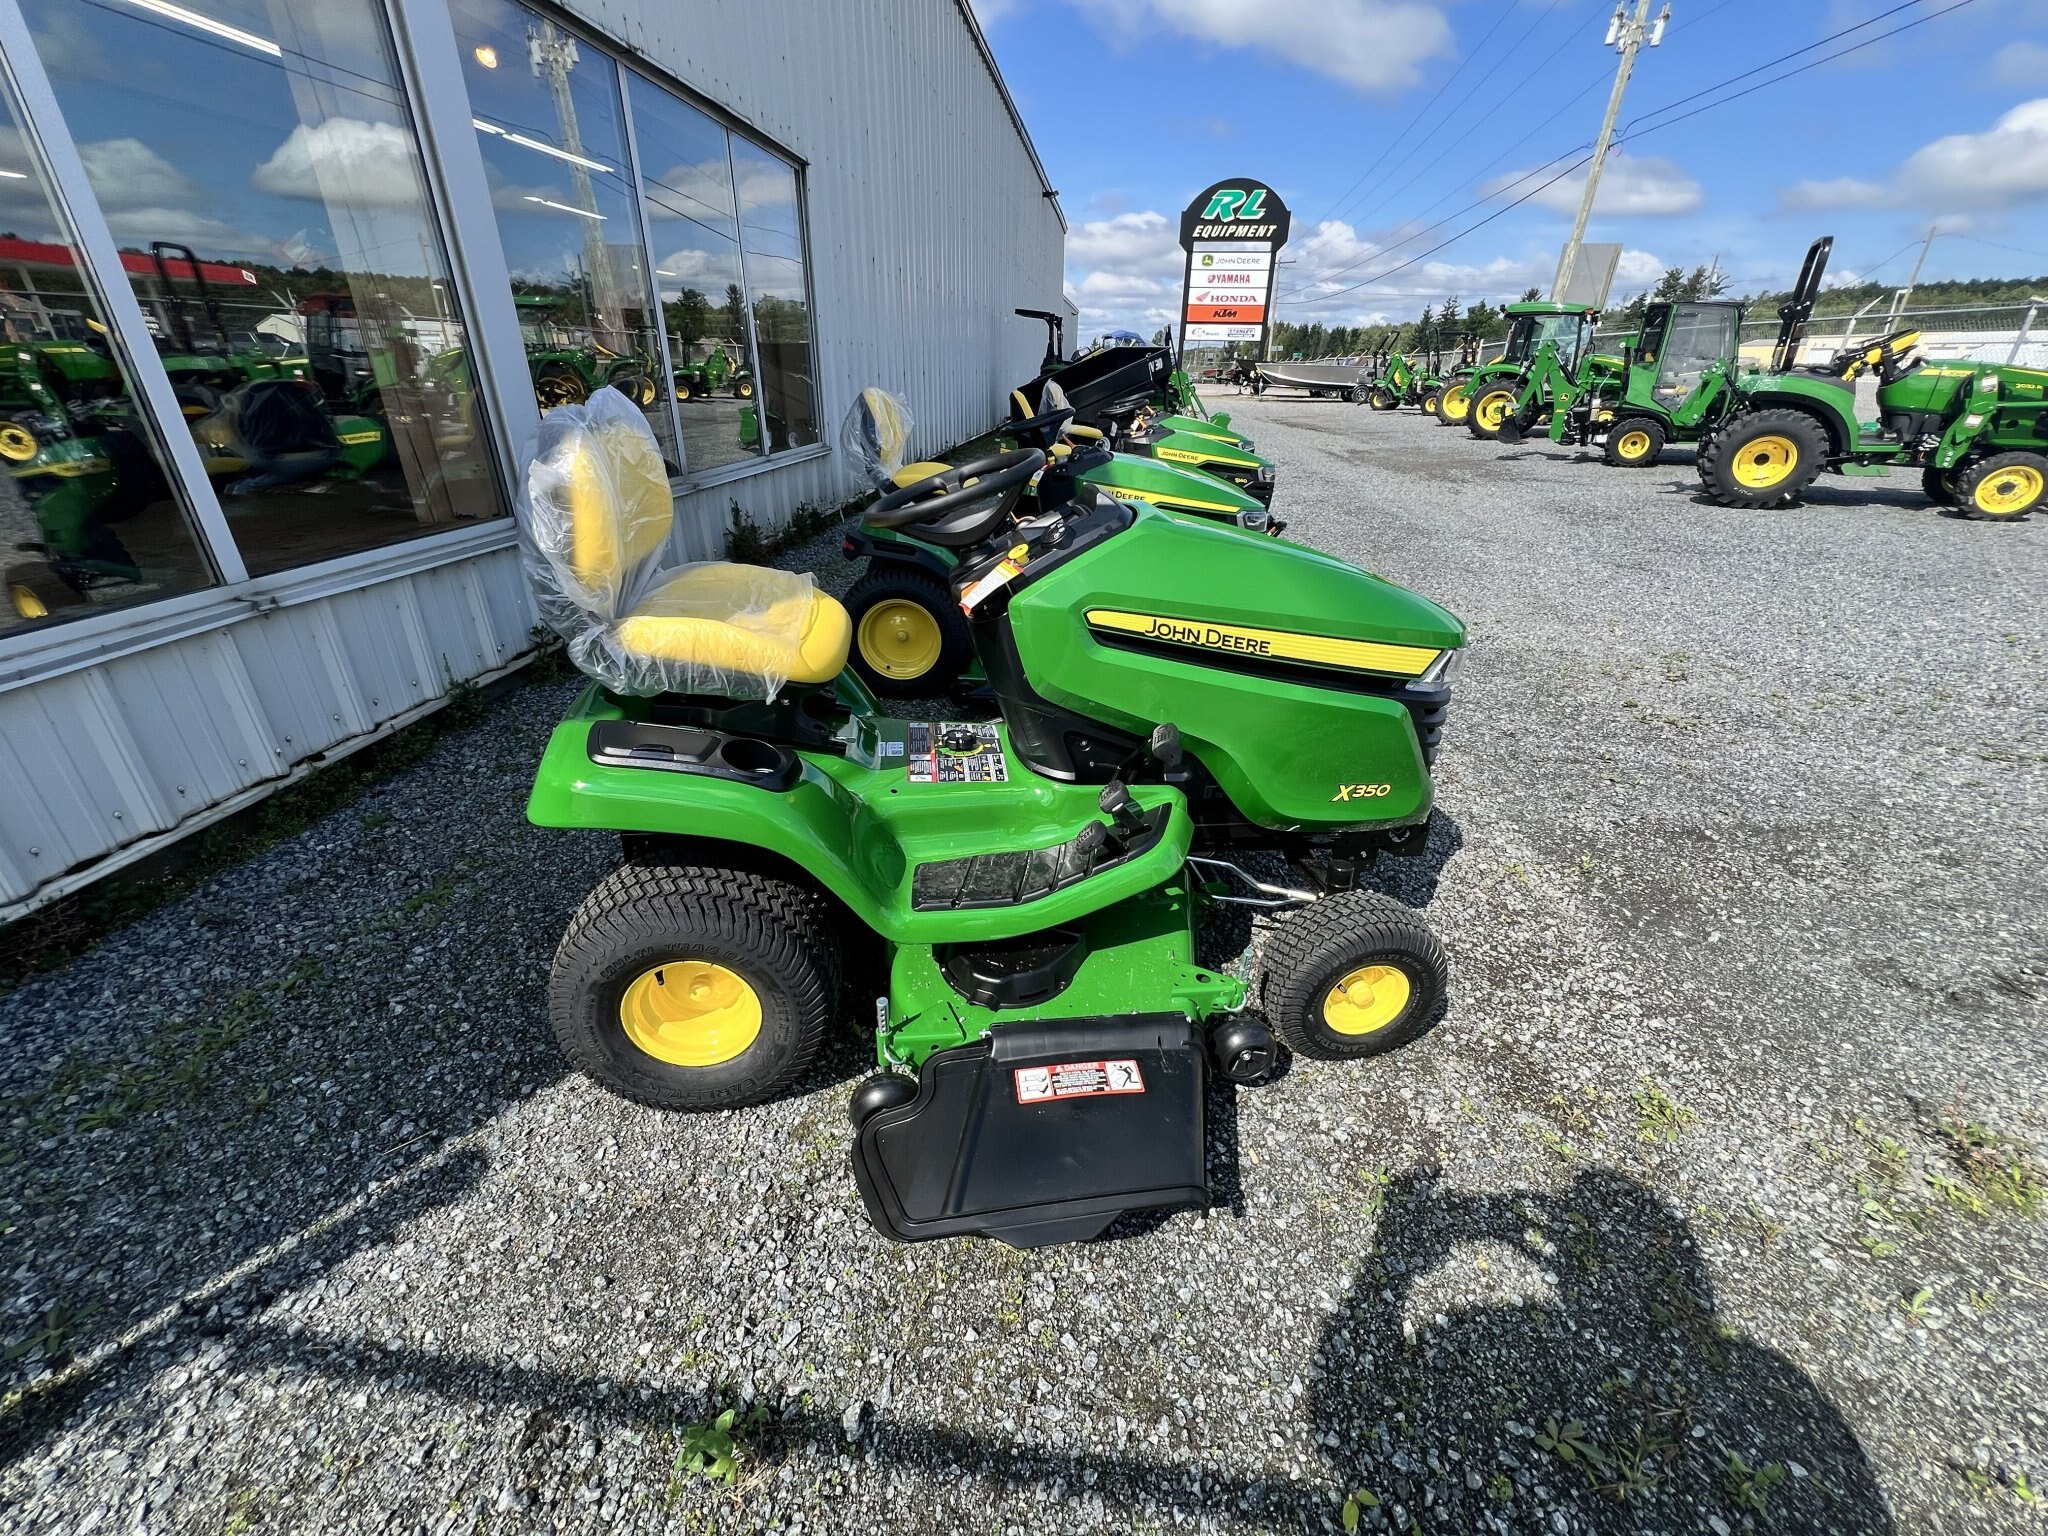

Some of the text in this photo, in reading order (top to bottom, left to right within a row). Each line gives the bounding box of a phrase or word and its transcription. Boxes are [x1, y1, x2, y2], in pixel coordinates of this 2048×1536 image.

[1200, 189, 1267, 222] RL
[1192, 225, 1278, 238] EQUIPMENT
[1217, 274, 1250, 283] YAMAHA
[1213, 309, 1237, 317] KTM
[1178, 452, 1199, 461] DEERE
[1144, 618, 1271, 654] JOHN DEERE
[1329, 784, 1391, 802] X350
[1064, 1063, 1099, 1071] DANGER
